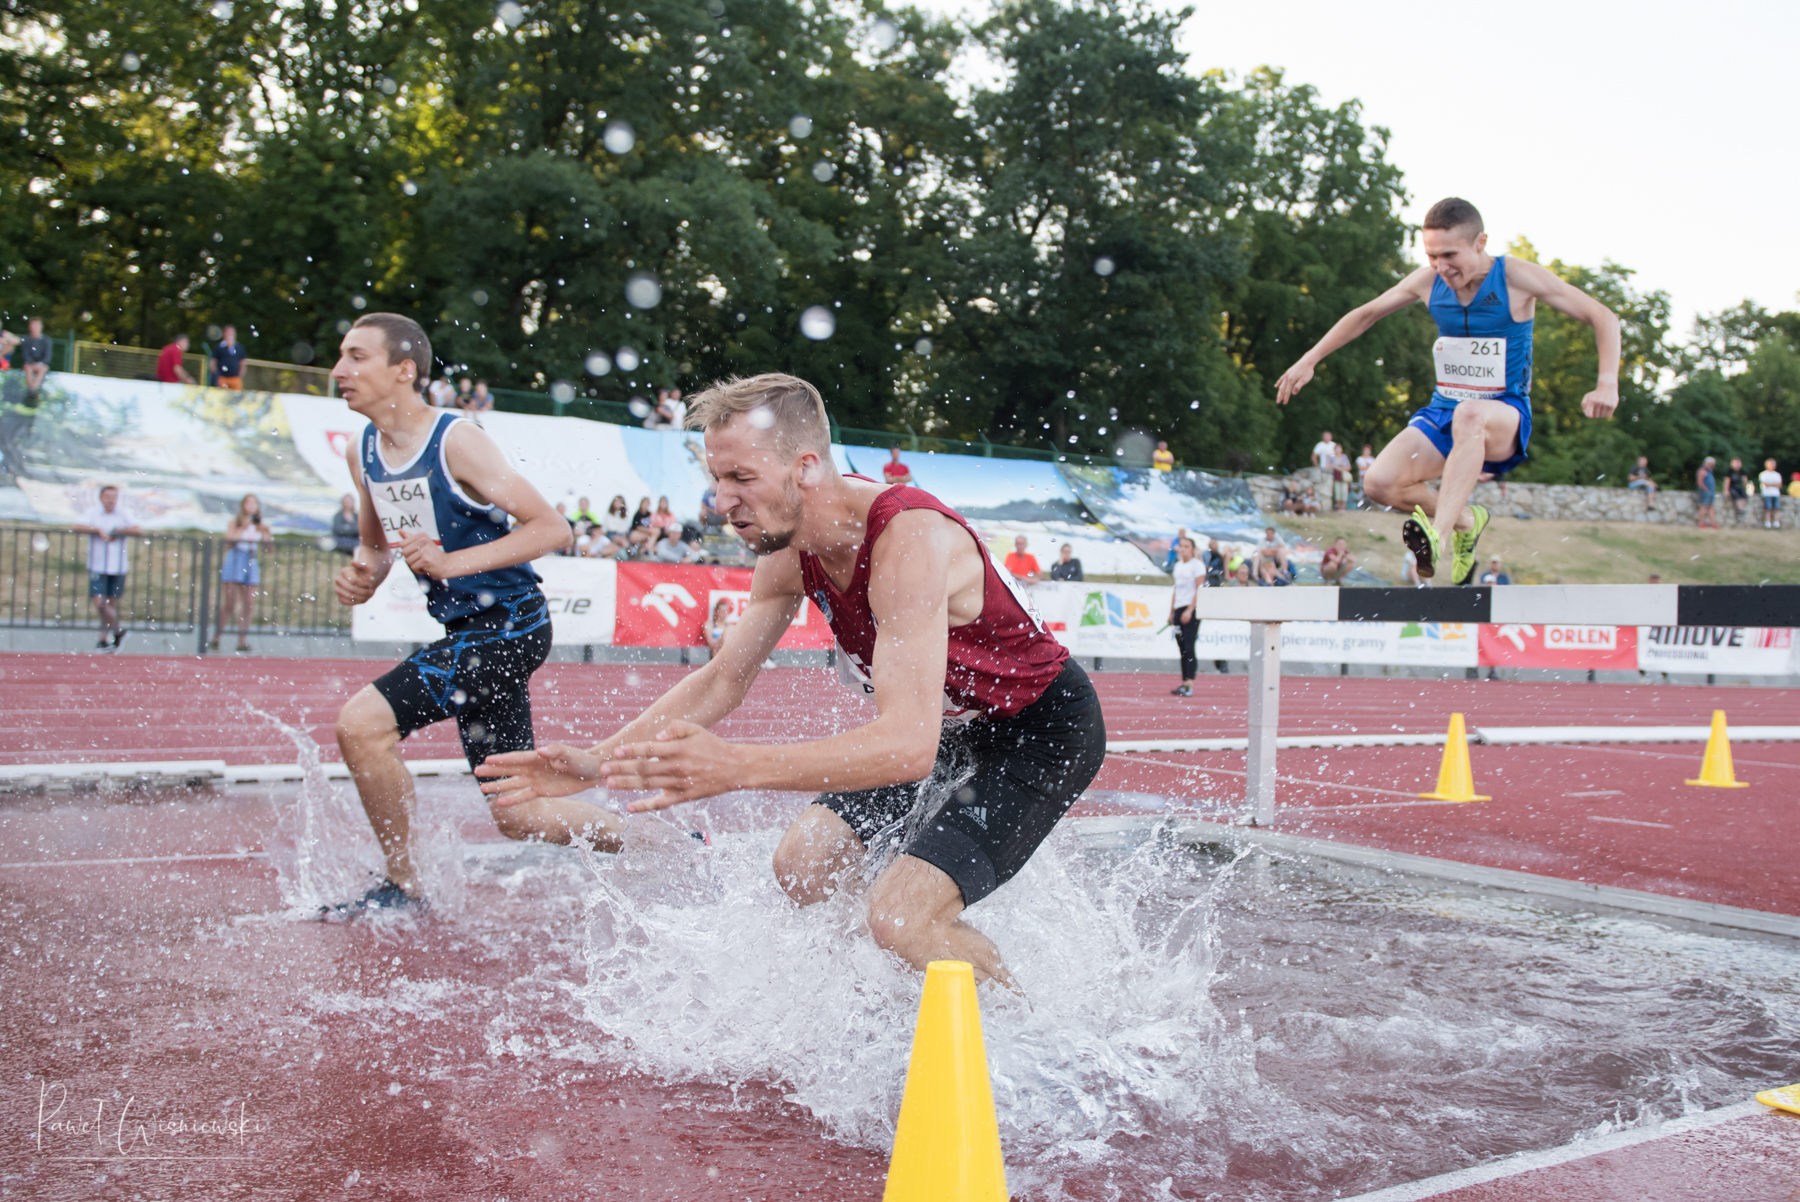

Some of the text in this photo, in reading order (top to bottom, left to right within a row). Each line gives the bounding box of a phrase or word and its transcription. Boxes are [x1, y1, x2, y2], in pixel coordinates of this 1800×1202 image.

[1470, 341, 1501, 355] 261
[1444, 363, 1495, 378] BRODZIK
[386, 483, 425, 502] 164
[381, 513, 422, 532] ELAK
[1281, 633, 1339, 650] pieramy,
[1343, 637, 1386, 651] gramy
[1550, 628, 1610, 645] ORLEN
[959, 807, 989, 831] adidas
